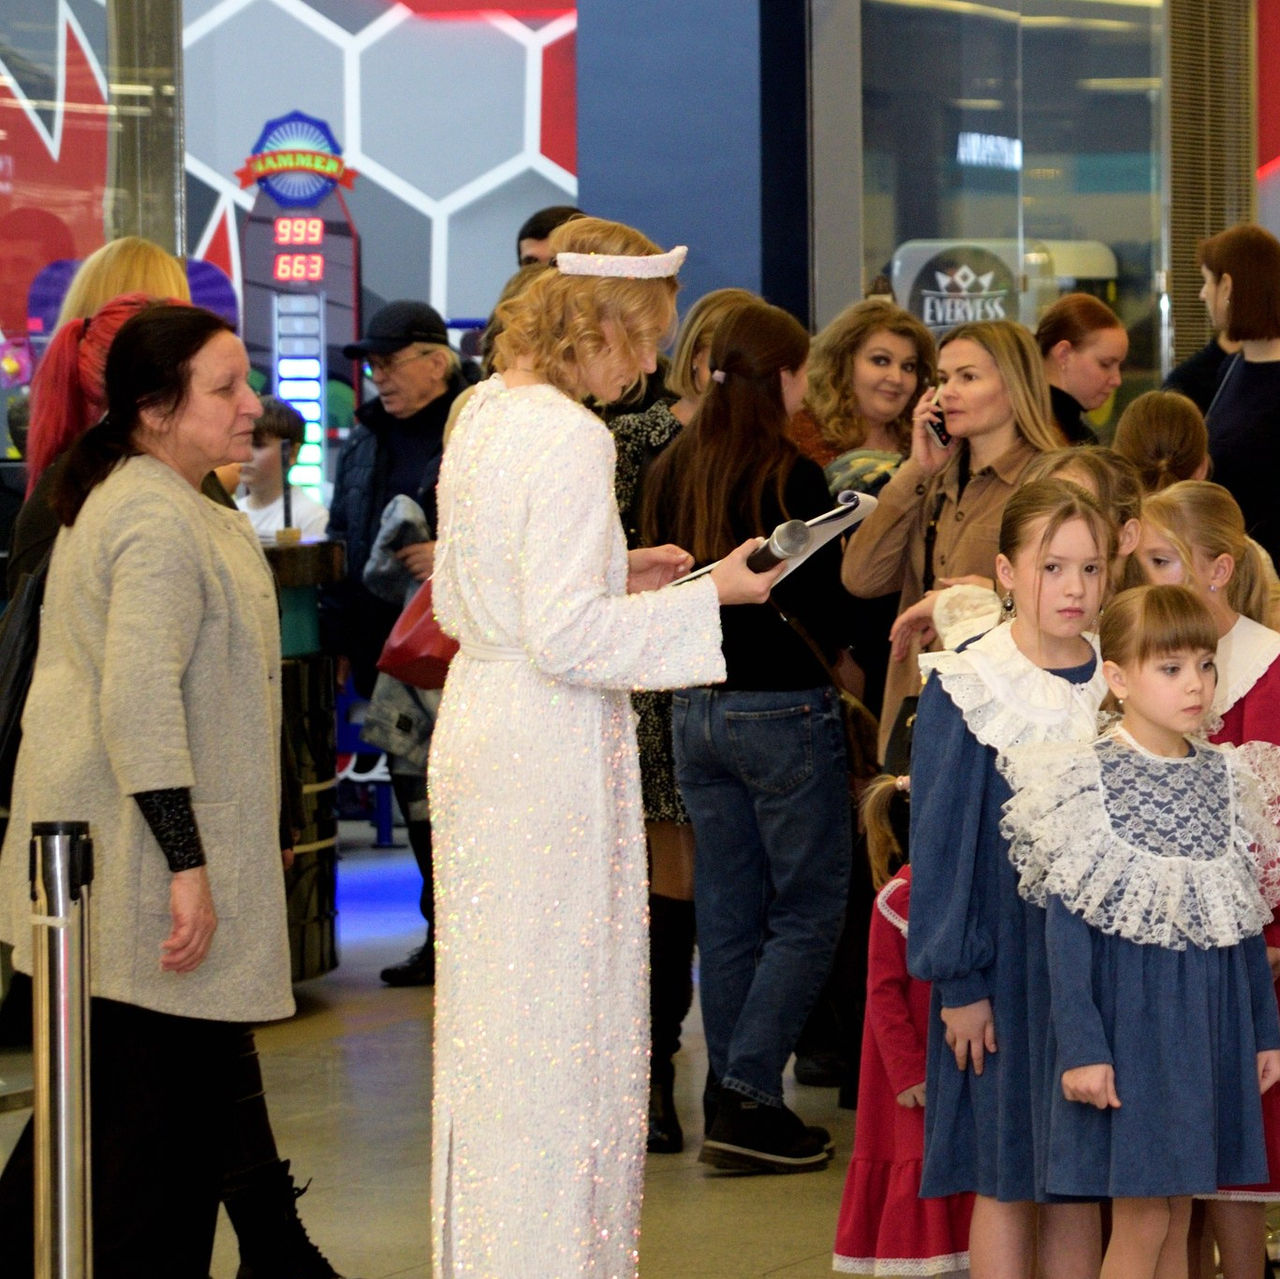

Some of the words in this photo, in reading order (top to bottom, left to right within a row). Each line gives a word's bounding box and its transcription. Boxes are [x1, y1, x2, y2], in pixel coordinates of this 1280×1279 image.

[275, 218, 324, 245] 999
[275, 254, 324, 281] 663
[923, 296, 1006, 323] EVERVESS
